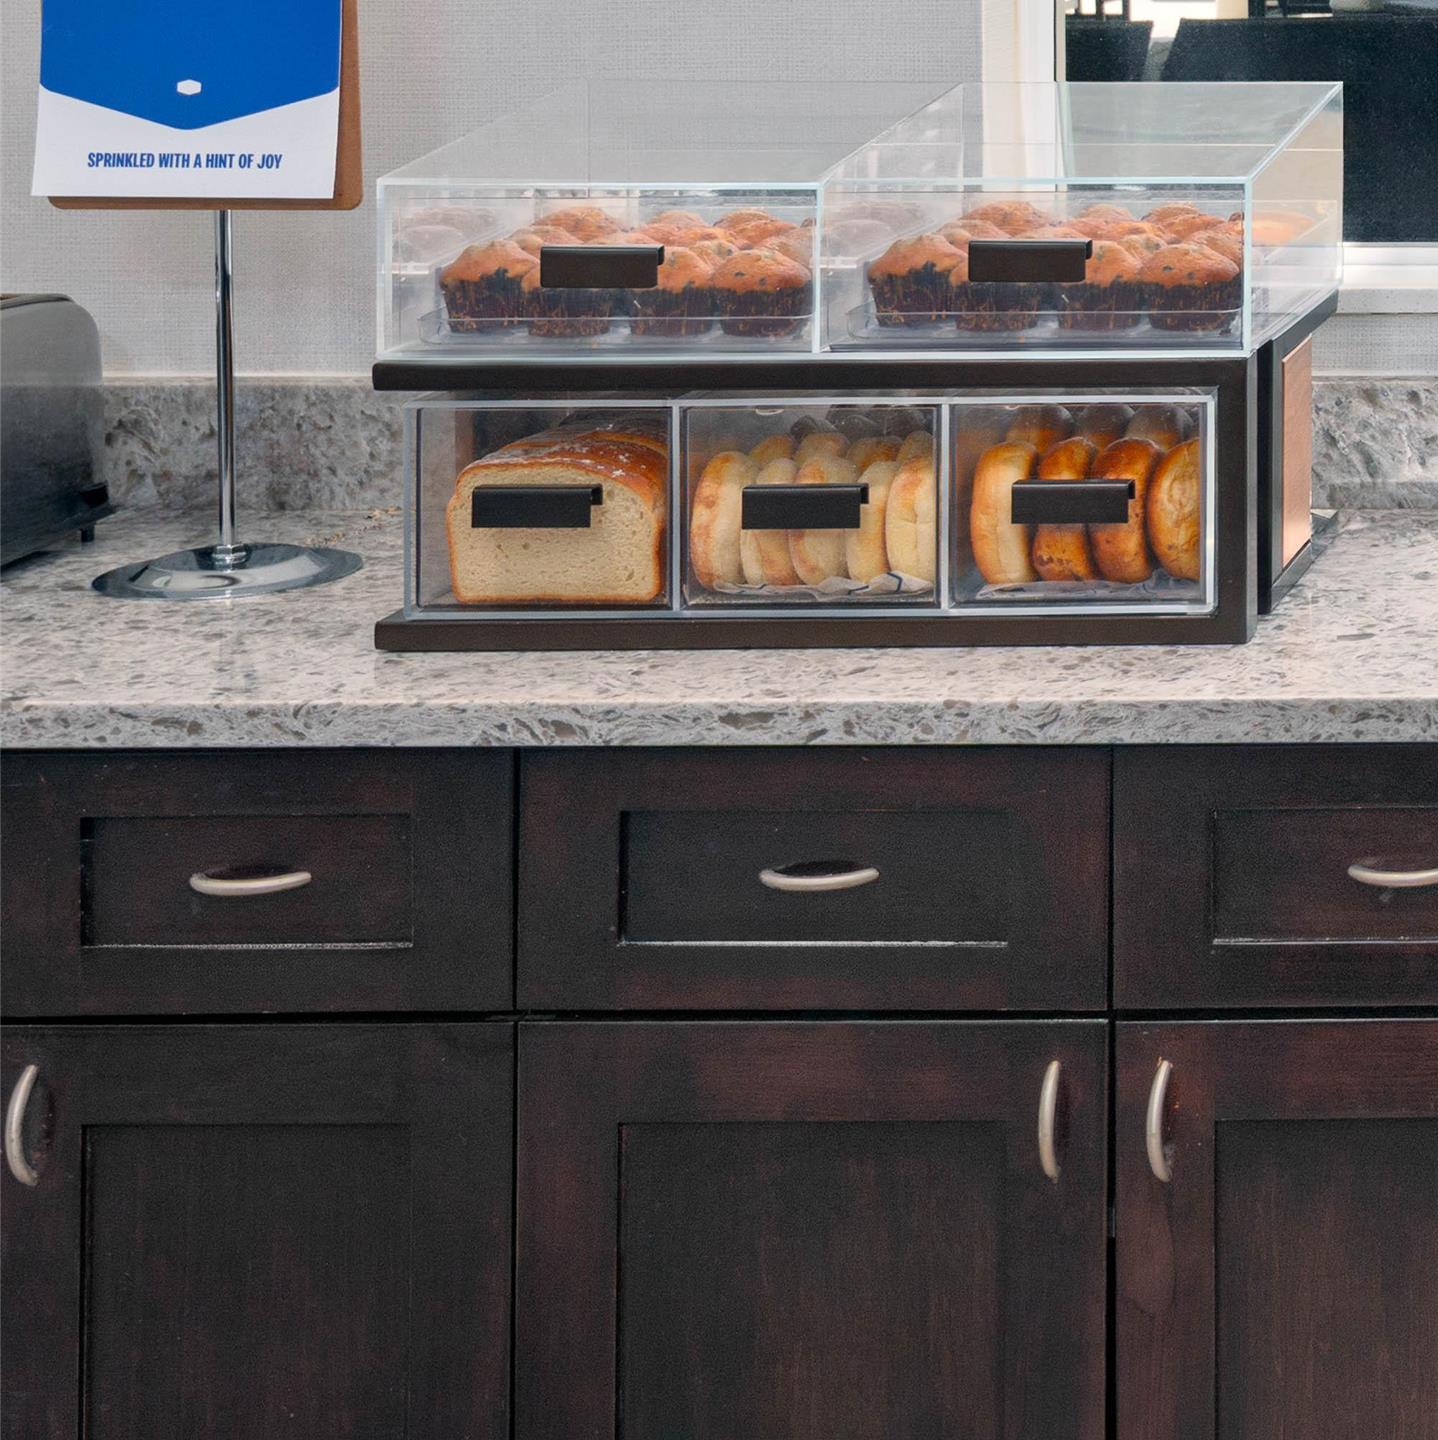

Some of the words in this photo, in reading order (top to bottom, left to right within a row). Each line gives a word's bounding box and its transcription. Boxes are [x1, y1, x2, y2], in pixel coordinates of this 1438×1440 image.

[88, 152, 155, 168] SPRINKLED
[158, 153, 190, 168] WITH
[193, 154, 202, 168] A
[205, 154, 235, 168] HINT
[238, 154, 254, 168] OF
[257, 154, 282, 169] JOY
